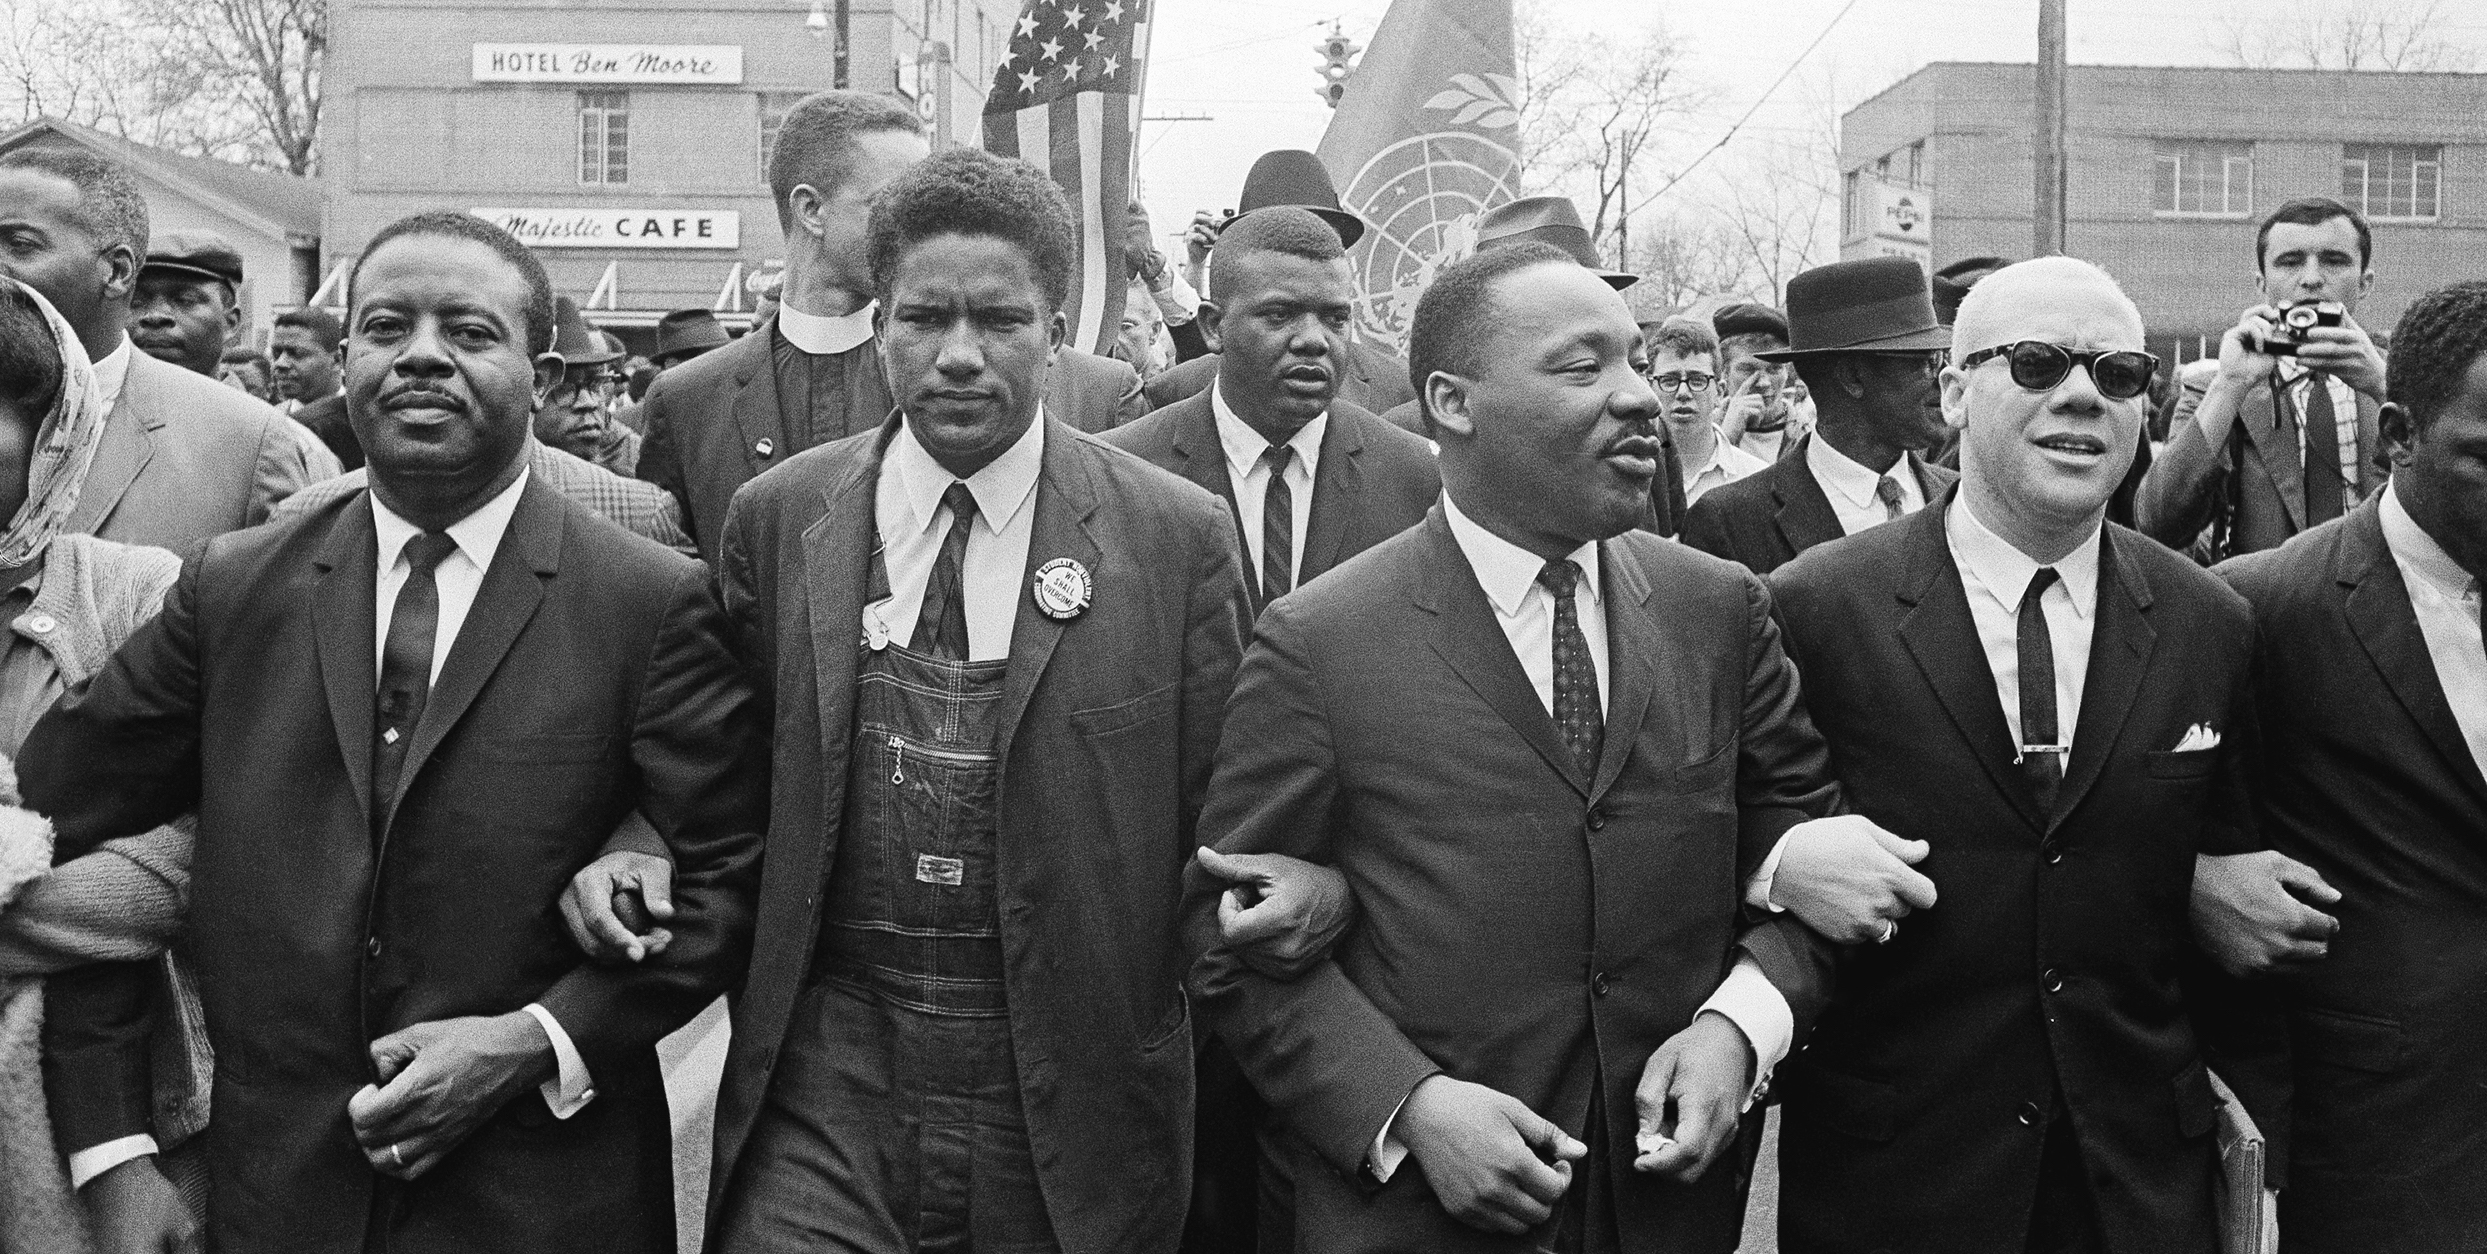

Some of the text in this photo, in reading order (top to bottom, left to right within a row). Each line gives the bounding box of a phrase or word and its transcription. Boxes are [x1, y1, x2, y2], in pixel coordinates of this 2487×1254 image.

[492, 50, 717, 74] HOTEL Ben Moore
[504, 215, 712, 240] Majestic CAFE
[1053, 578, 1075, 596] SHALL
[1065, 571, 1076, 582] WE
[1043, 584, 1075, 608] OVERCOME
